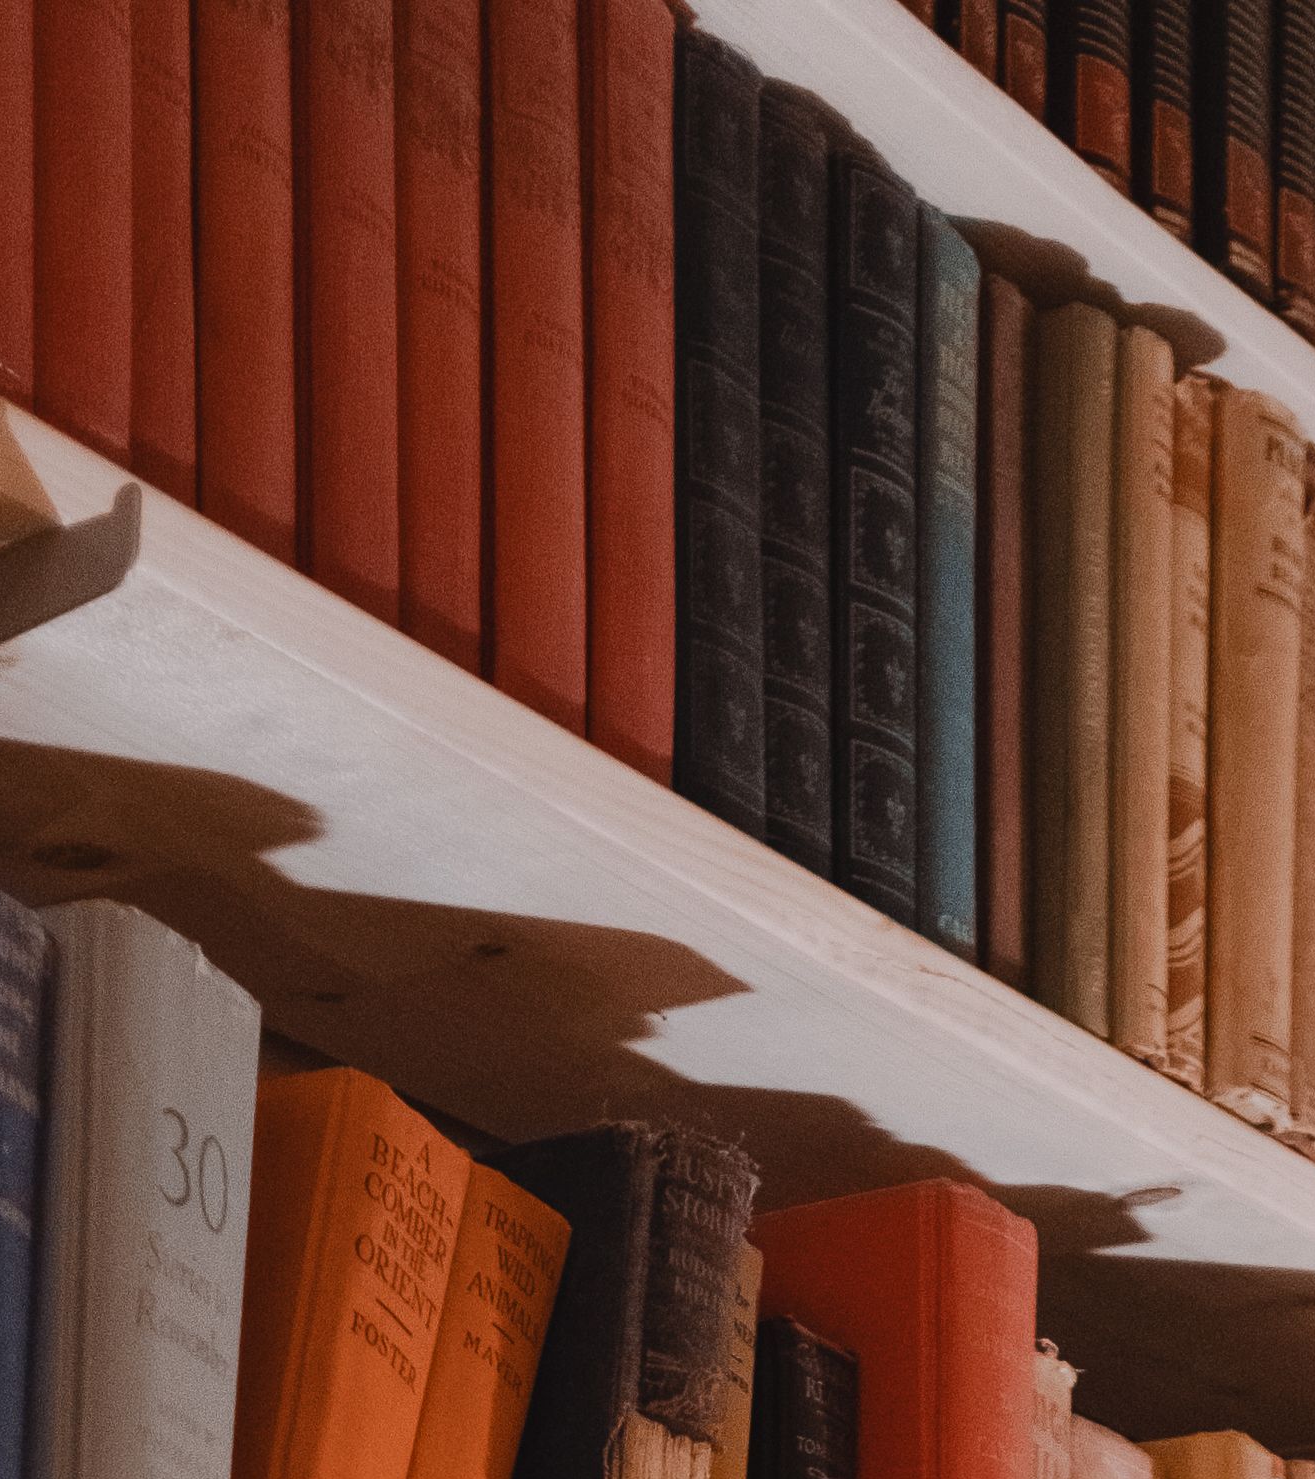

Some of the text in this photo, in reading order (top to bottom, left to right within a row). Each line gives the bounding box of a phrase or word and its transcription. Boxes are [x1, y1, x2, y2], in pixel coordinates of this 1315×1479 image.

[157, 1105, 229, 1235] 30
[416, 1140, 433, 1175] A
[662, 1183, 737, 1247] STORI
[353, 1232, 438, 1331] ORIENT
[495, 1243, 537, 1299] WILD
[349, 1310, 418, 1394] FOSTER
